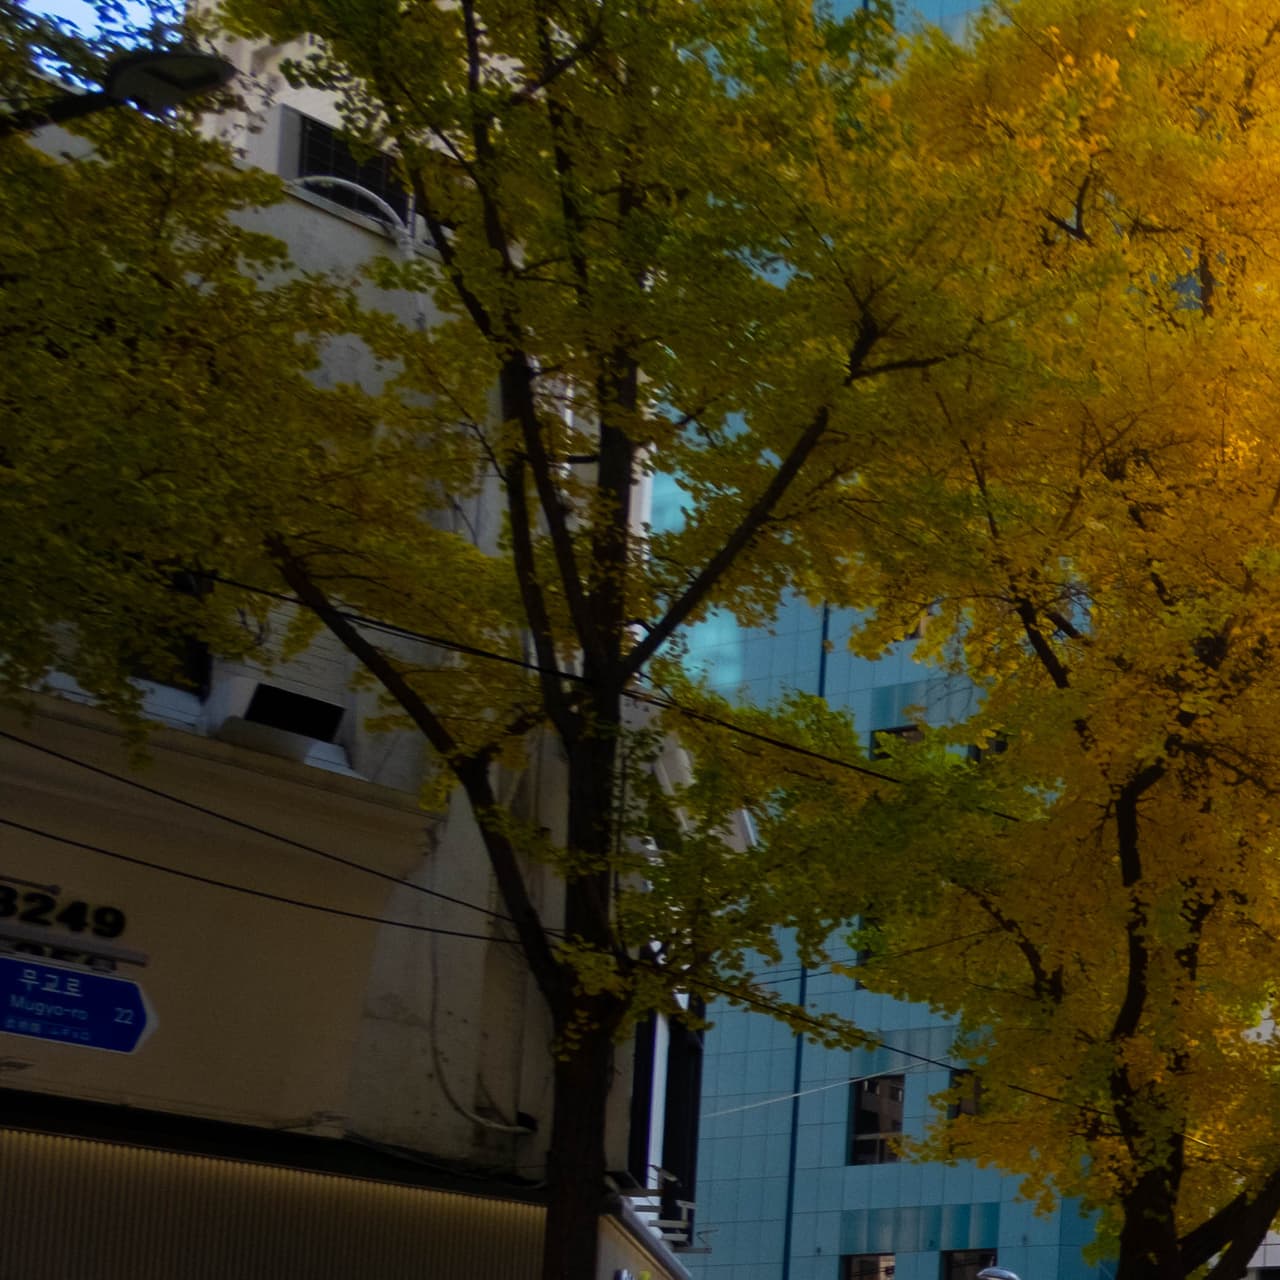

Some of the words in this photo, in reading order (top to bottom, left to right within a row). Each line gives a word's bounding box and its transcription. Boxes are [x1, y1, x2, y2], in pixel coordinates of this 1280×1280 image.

[17, 968, 84, 998] 무교로
[8, 994, 89, 1021] Mugyo-ro
[113, 1008, 135, 1025] 22
